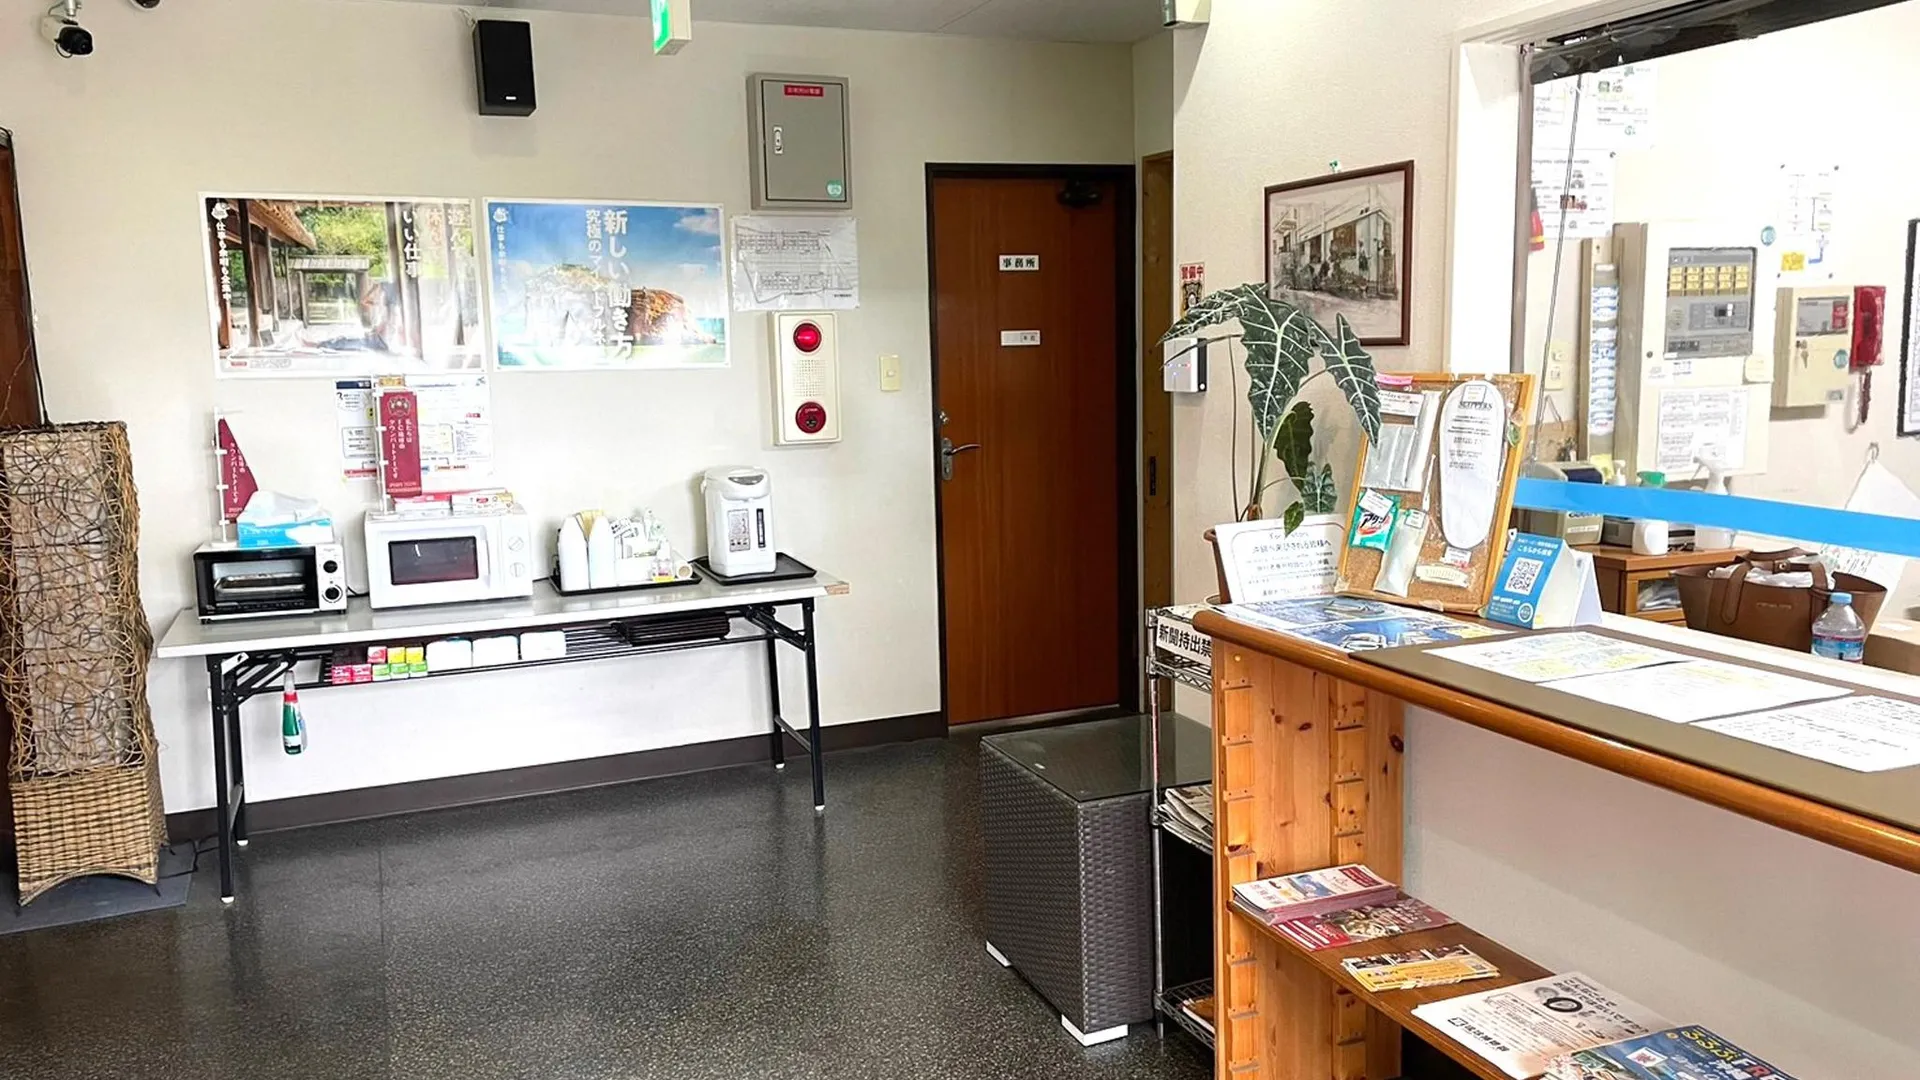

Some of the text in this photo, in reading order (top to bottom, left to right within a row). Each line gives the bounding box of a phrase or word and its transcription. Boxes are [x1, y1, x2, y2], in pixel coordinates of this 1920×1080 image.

[1003, 258, 1036, 269] 事務所
[604, 209, 633, 359] 新しい働き方
[1681, 1029, 1741, 1062] るるぶ
